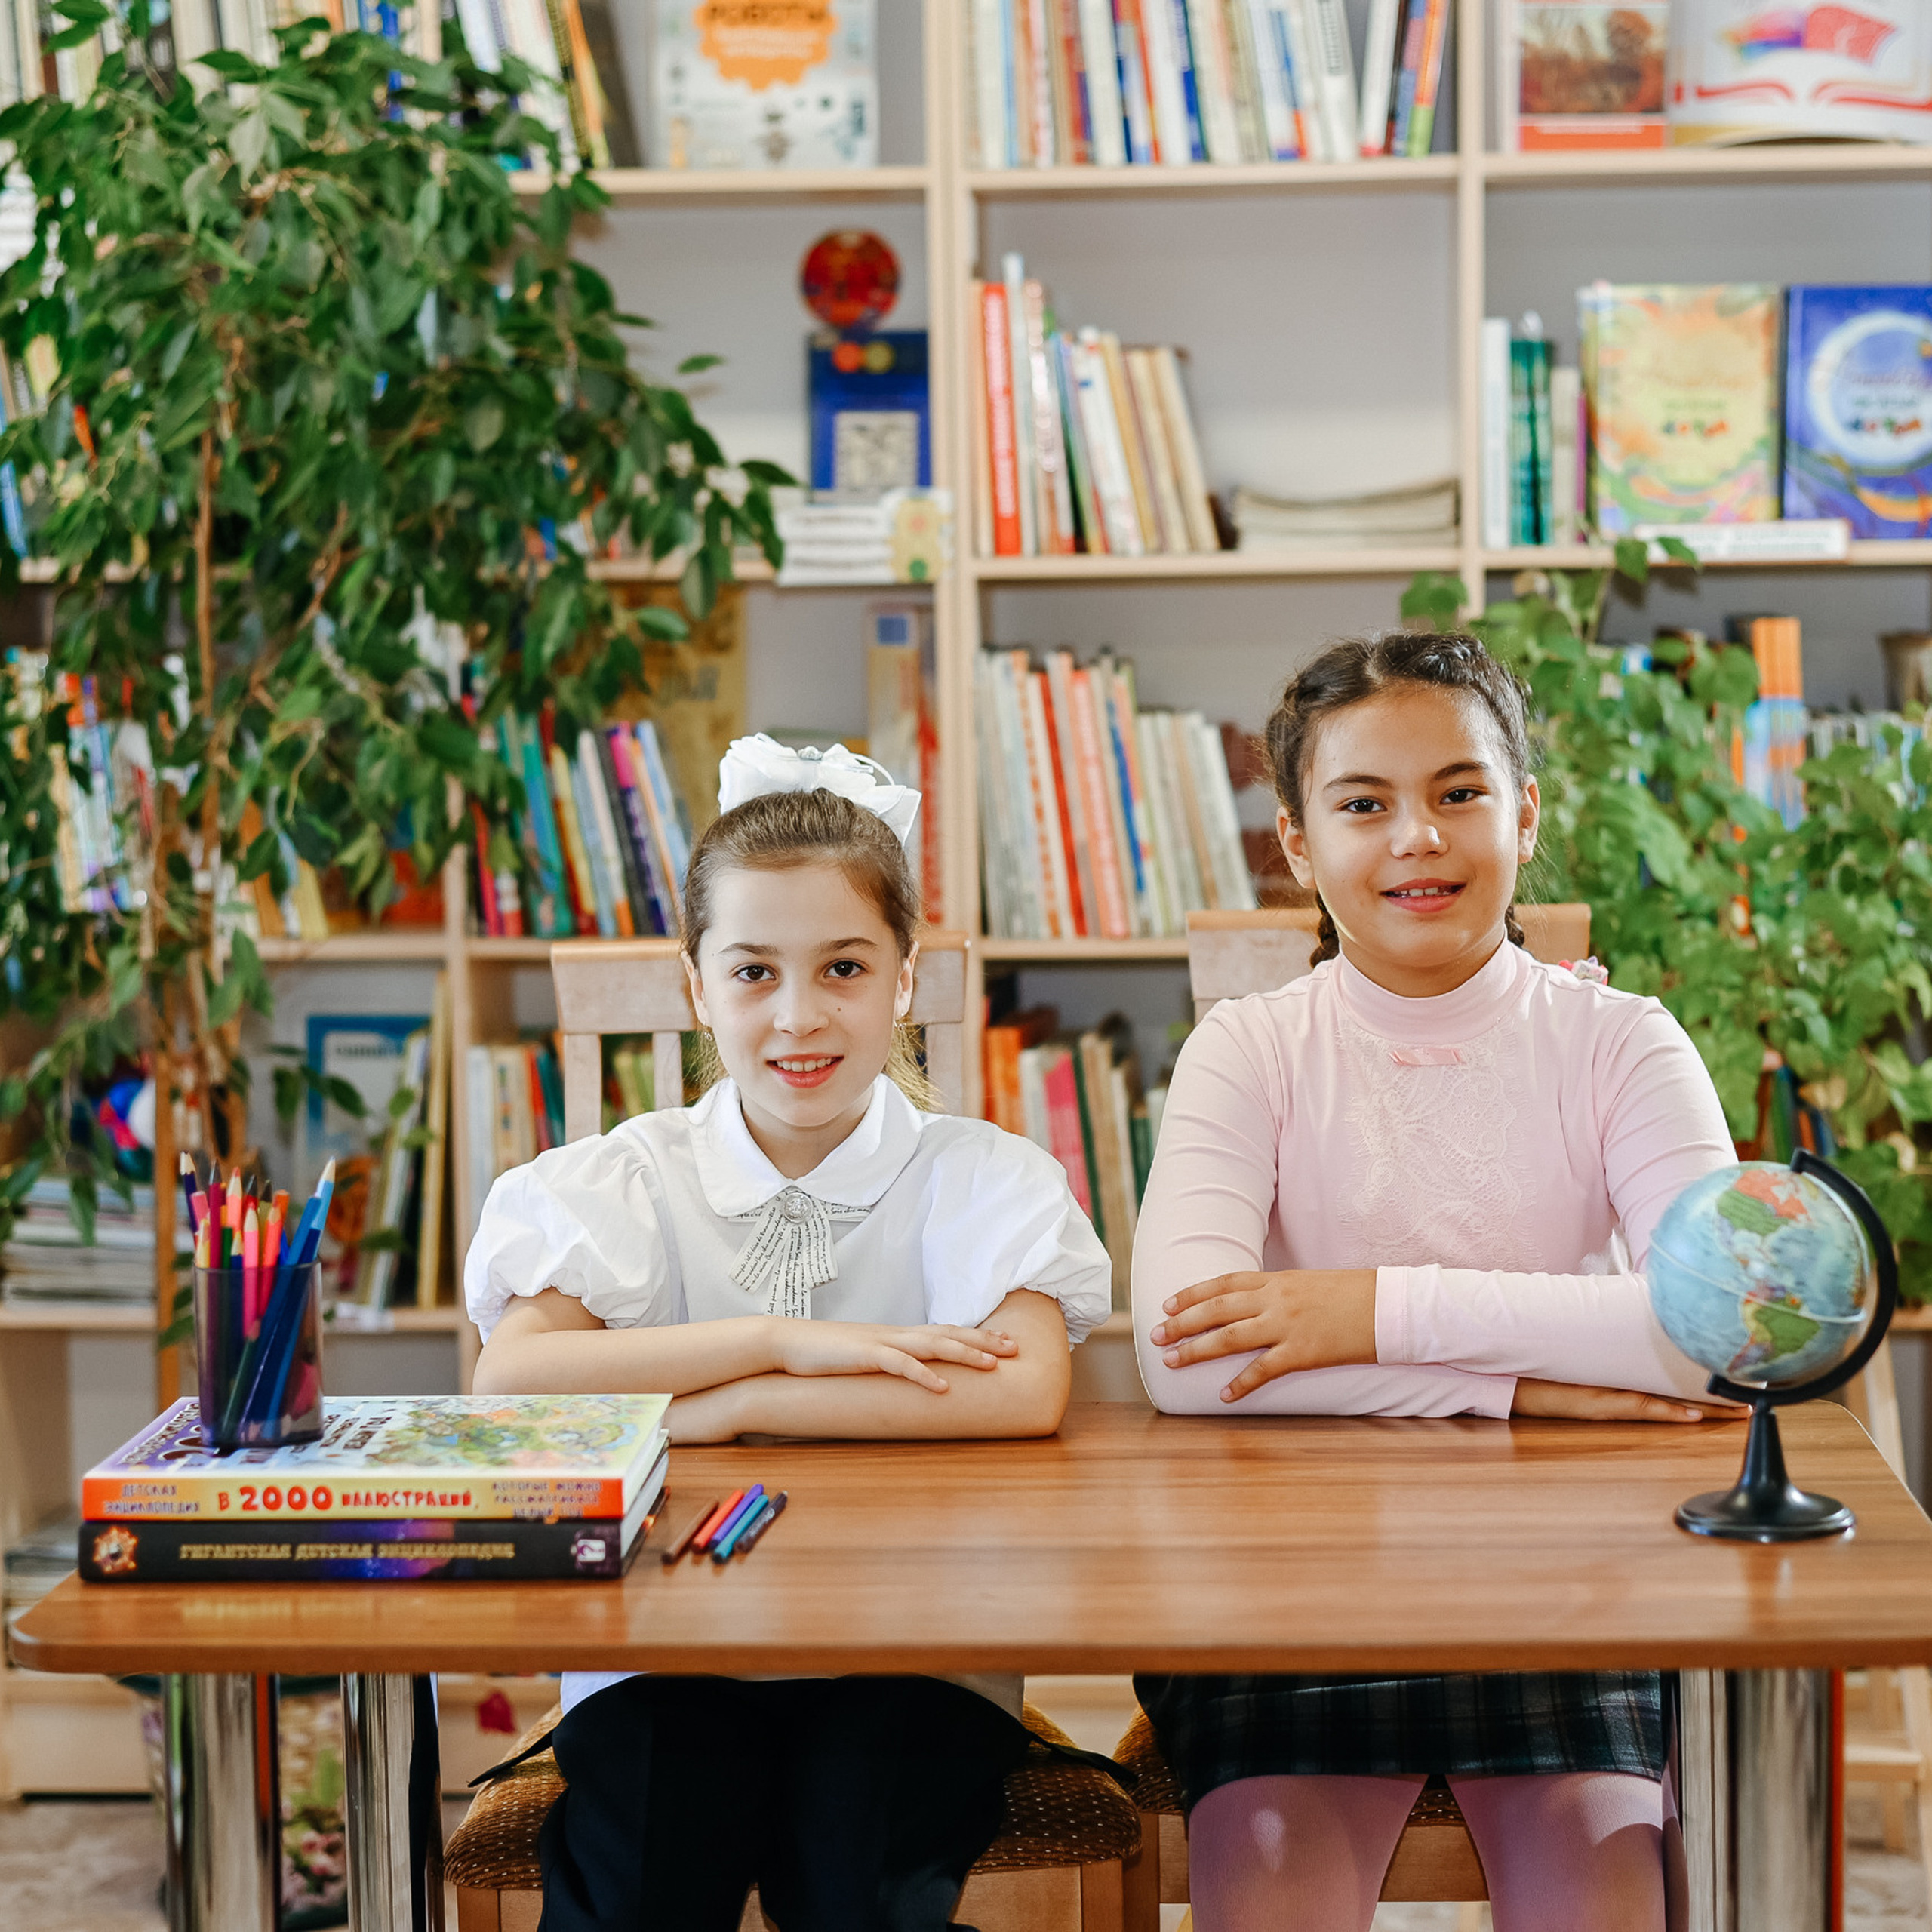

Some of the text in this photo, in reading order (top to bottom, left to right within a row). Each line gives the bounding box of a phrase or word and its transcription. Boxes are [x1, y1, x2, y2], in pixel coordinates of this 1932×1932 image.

[122, 1484, 177, 1497] ДЕТСКАЯ
[240, 1485, 333, 1511] 2000
[104, 1501, 200, 1514] ЭНЦИКЛОПЕДИЯ
[179, 1543, 515, 1561] ГИГАНТСКАЯ ДЕТСКАЯ ЭНЦИКЛОПЕДИЯ
